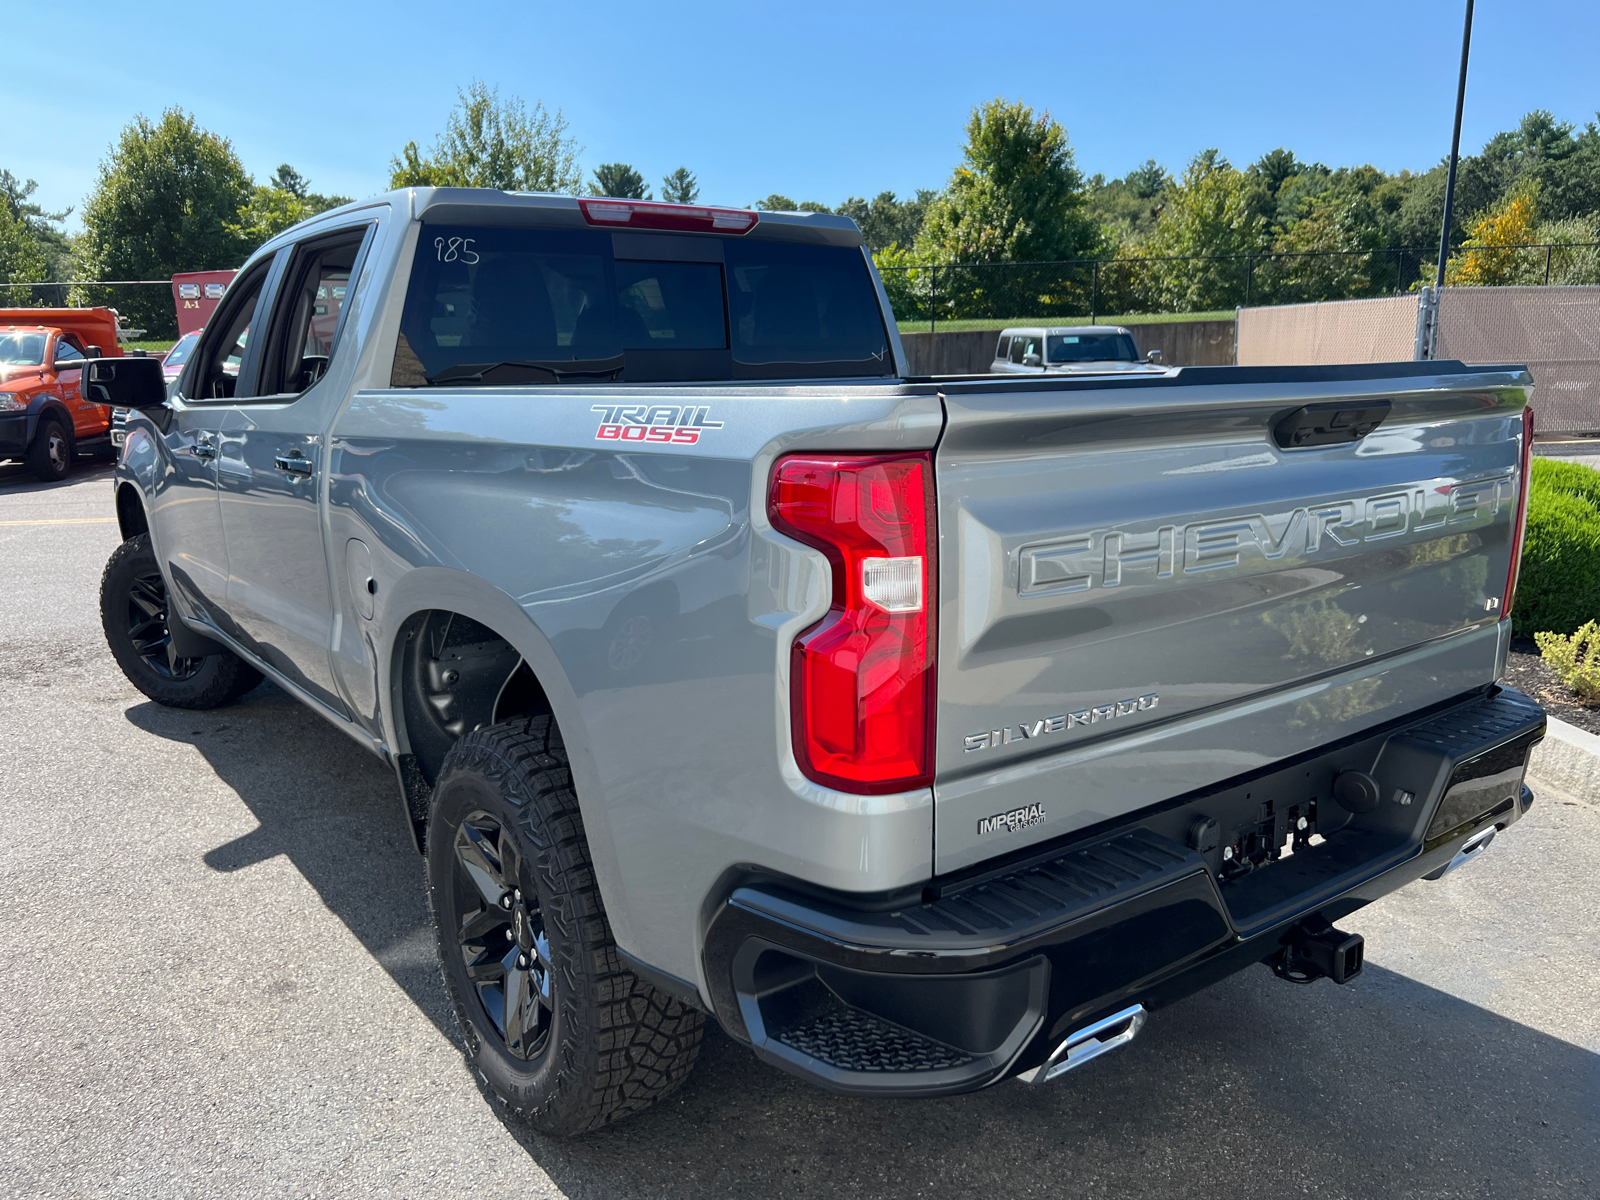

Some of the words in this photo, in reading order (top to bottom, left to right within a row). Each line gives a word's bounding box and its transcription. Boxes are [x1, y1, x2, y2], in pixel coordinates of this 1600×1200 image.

[434, 236, 480, 265] 985
[183, 300, 200, 309] A-1
[590, 404, 725, 429] TRAIL
[595, 424, 702, 445] BOSS
[1017, 475, 1511, 599] CHEVROLET
[963, 693, 1160, 753] SILVERADO
[978, 803, 1046, 835] IMPERIAL
[1009, 815, 1046, 832] cars.com
